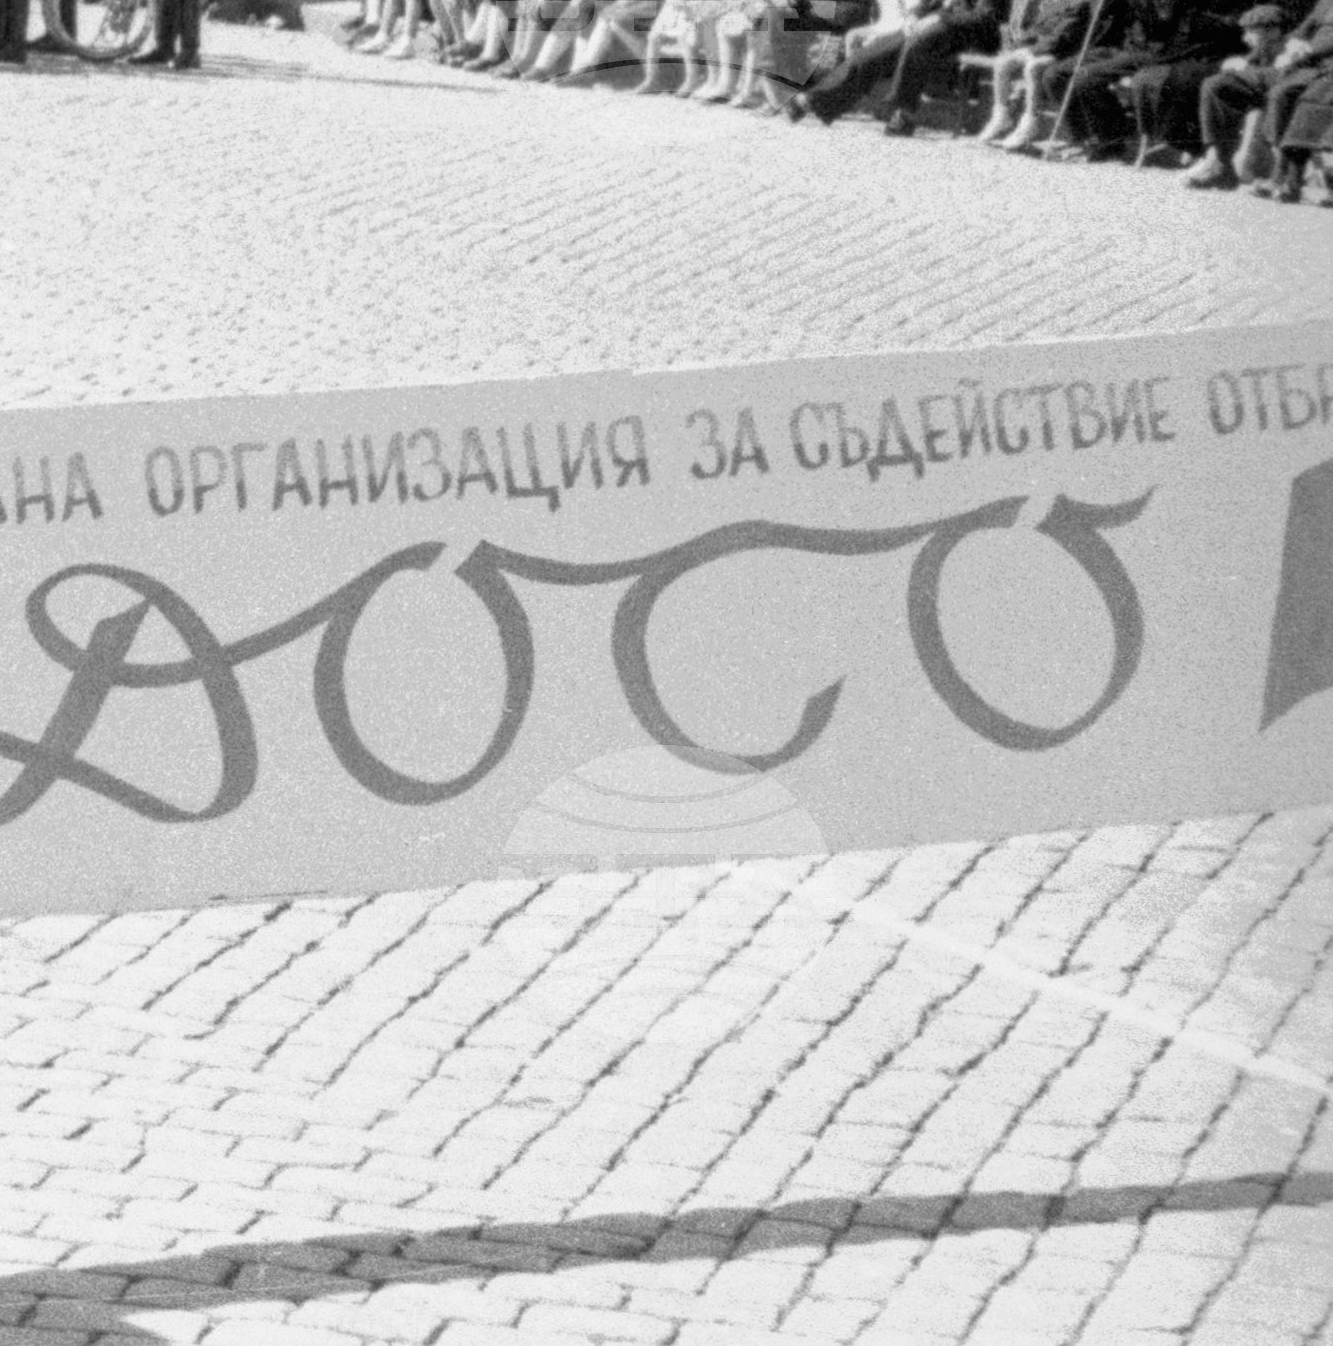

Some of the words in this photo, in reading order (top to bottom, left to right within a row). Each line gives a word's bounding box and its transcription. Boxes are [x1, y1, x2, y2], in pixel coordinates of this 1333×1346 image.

[144, 414, 651, 518] ОРГАНИЗАЦИЯ
[685, 406, 770, 480] ЗА
[788, 376, 1177, 483] СЪДЕЙСТВИЕ
